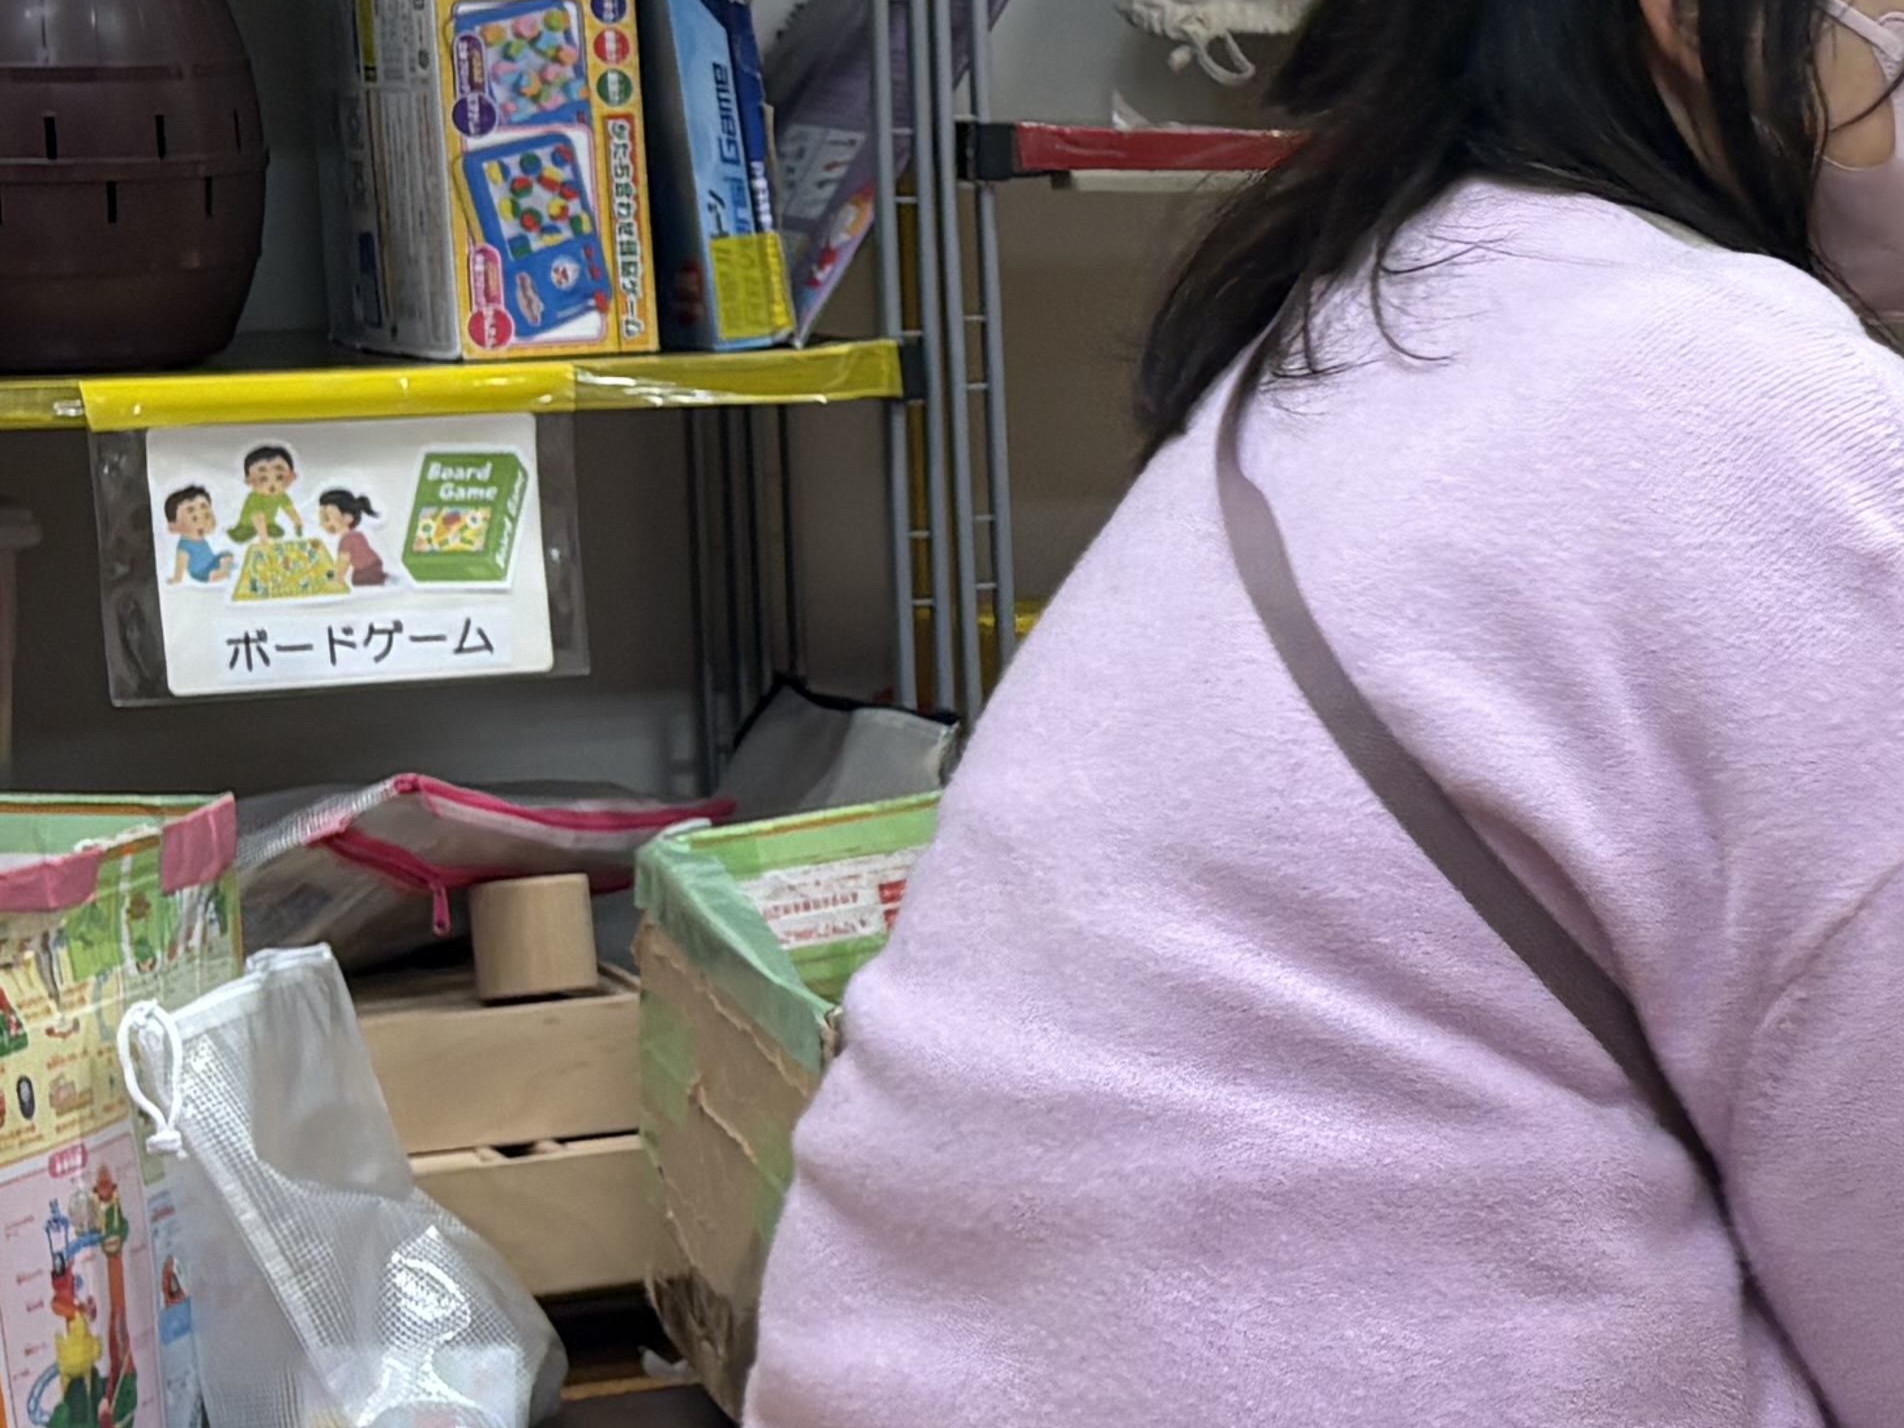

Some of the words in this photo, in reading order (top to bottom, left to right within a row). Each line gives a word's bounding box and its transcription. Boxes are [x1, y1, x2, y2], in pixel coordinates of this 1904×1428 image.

[711, 62, 741, 166] Game
[427, 460, 493, 483] Board
[438, 482, 498, 502] Game
[226, 616, 495, 673] ボードゲーム
